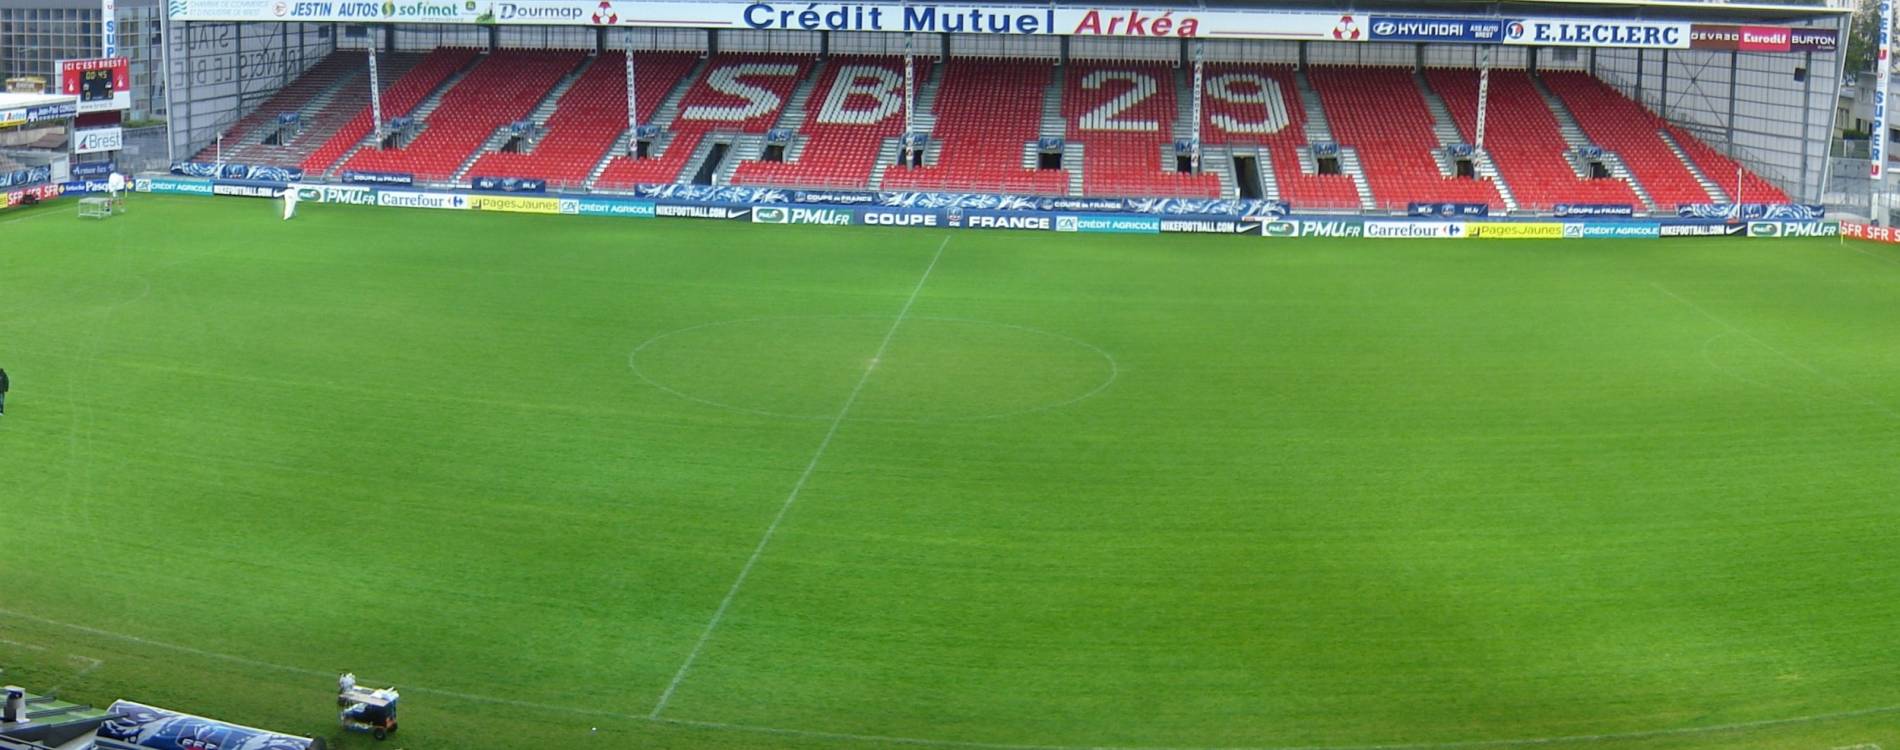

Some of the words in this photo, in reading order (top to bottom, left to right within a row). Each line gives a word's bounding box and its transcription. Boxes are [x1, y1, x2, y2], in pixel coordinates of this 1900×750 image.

[291, 3, 331, 17] JESTIN
[338, 3, 378, 17] AUTOS
[399, 3, 458, 17] sofimat
[500, 3, 583, 20] Dourmap
[744, 2, 883, 30] Crédit
[903, 6, 1055, 34] Mutuel
[1074, 10, 1199, 37] Arkéa
[1398, 23, 1464, 36] HYUNDAI
[1534, 23, 1680, 45] E.LECLERC
[1743, 32, 1787, 44] Eurodif
[1792, 35, 1836, 45] BURTON
[64, 63, 75, 71] ICI
[76, 61, 97, 70] C'EST
[99, 60, 124, 69] BREST
[1872, 91, 1885, 161] SUPER
[89, 134, 120, 149] Brest
[384, 176, 412, 184] FRANCE
[85, 181, 110, 193] Pasq
[177, 183, 213, 193] AGRICOLE
[381, 193, 445, 207] Carrefour
[806, 193, 832, 201] COUPE
[482, 198, 559, 211] PagesJaunes
[579, 202, 609, 213] CRÉDIT
[611, 205, 655, 215] AGRICOLE
[1567, 207, 1594, 215] COUPE
[1600, 207, 1632, 215] FRANCE
[655, 204, 727, 219] NIKEFOOTBALL.COM
[864, 213, 937, 226] COUPE
[968, 216, 1050, 229] FRANCE
[1078, 218, 1111, 229] CRÉDIT
[1112, 220, 1160, 230] AGRICOLE
[1160, 221, 1235, 233] NIKEFOOTBALL.COM
[1367, 223, 1440, 237] Carrefour
[1481, 224, 1562, 237] PagesJaunes
[1583, 225, 1615, 235] CRÉDIT
[1615, 226, 1659, 236] AGRICOLE
[1660, 225, 1725, 236] NIKEFOOTBALL.COM
[1841, 222, 1863, 237] SFR
[1867, 225, 1890, 241] SFR
